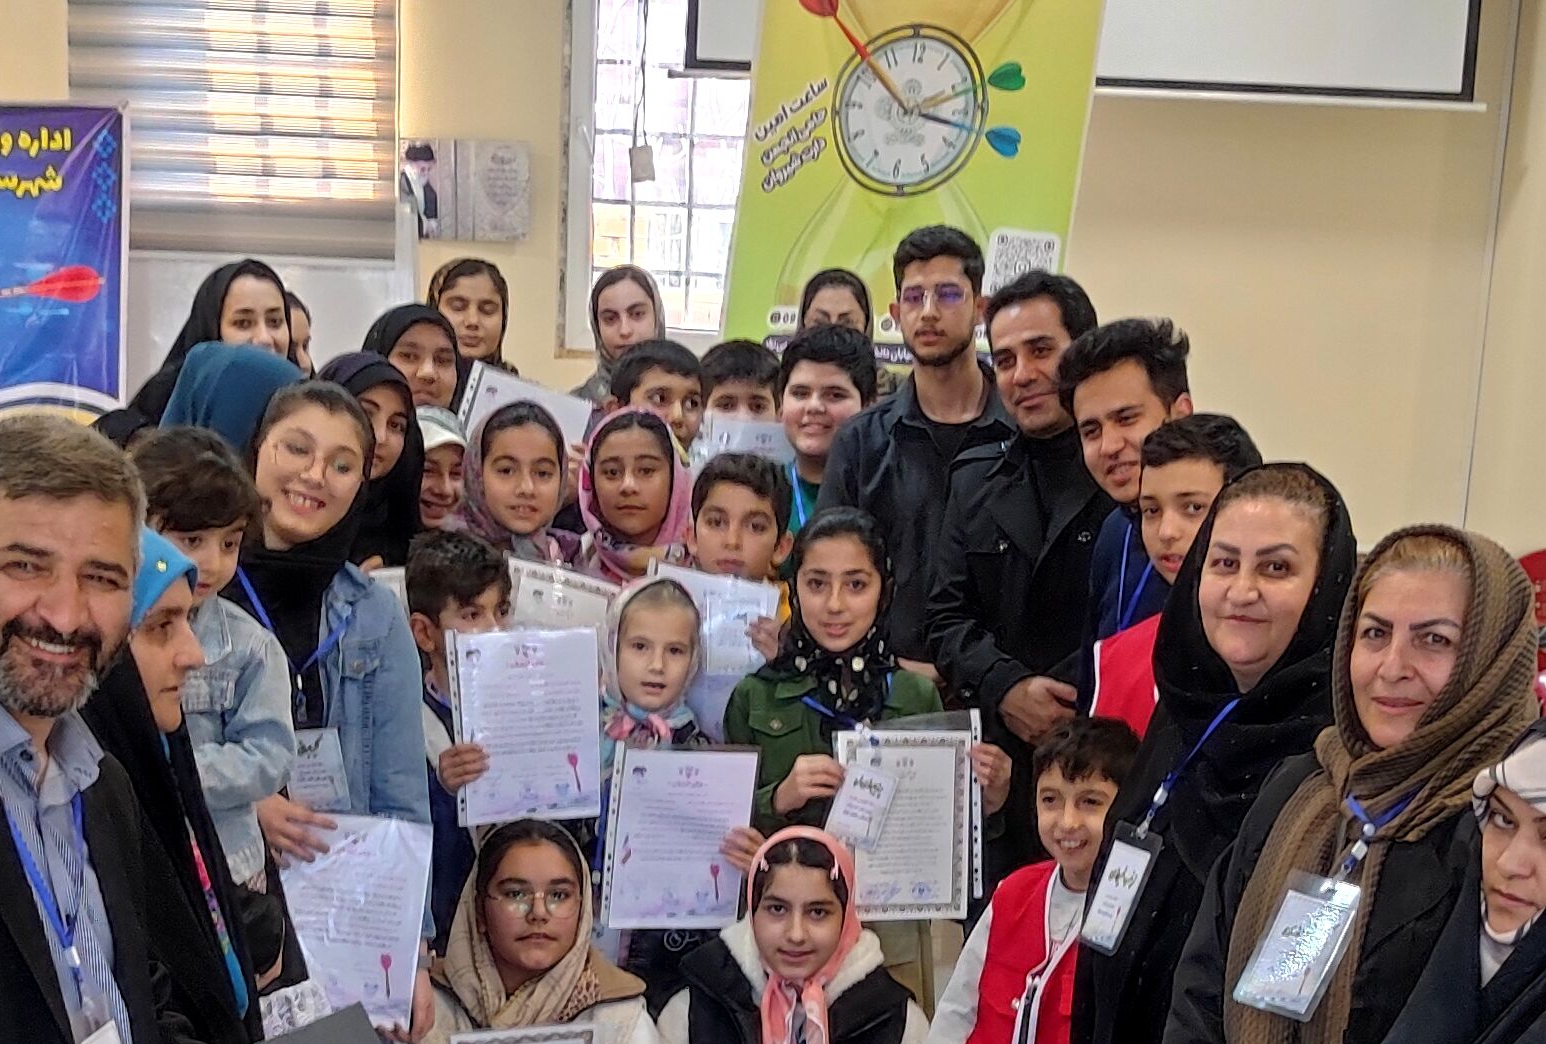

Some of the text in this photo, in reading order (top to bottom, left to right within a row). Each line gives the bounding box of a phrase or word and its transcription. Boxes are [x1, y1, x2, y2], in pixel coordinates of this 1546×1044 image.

[755, 77, 828, 142] ساعت امین
[18, 126, 73, 158] اداره
